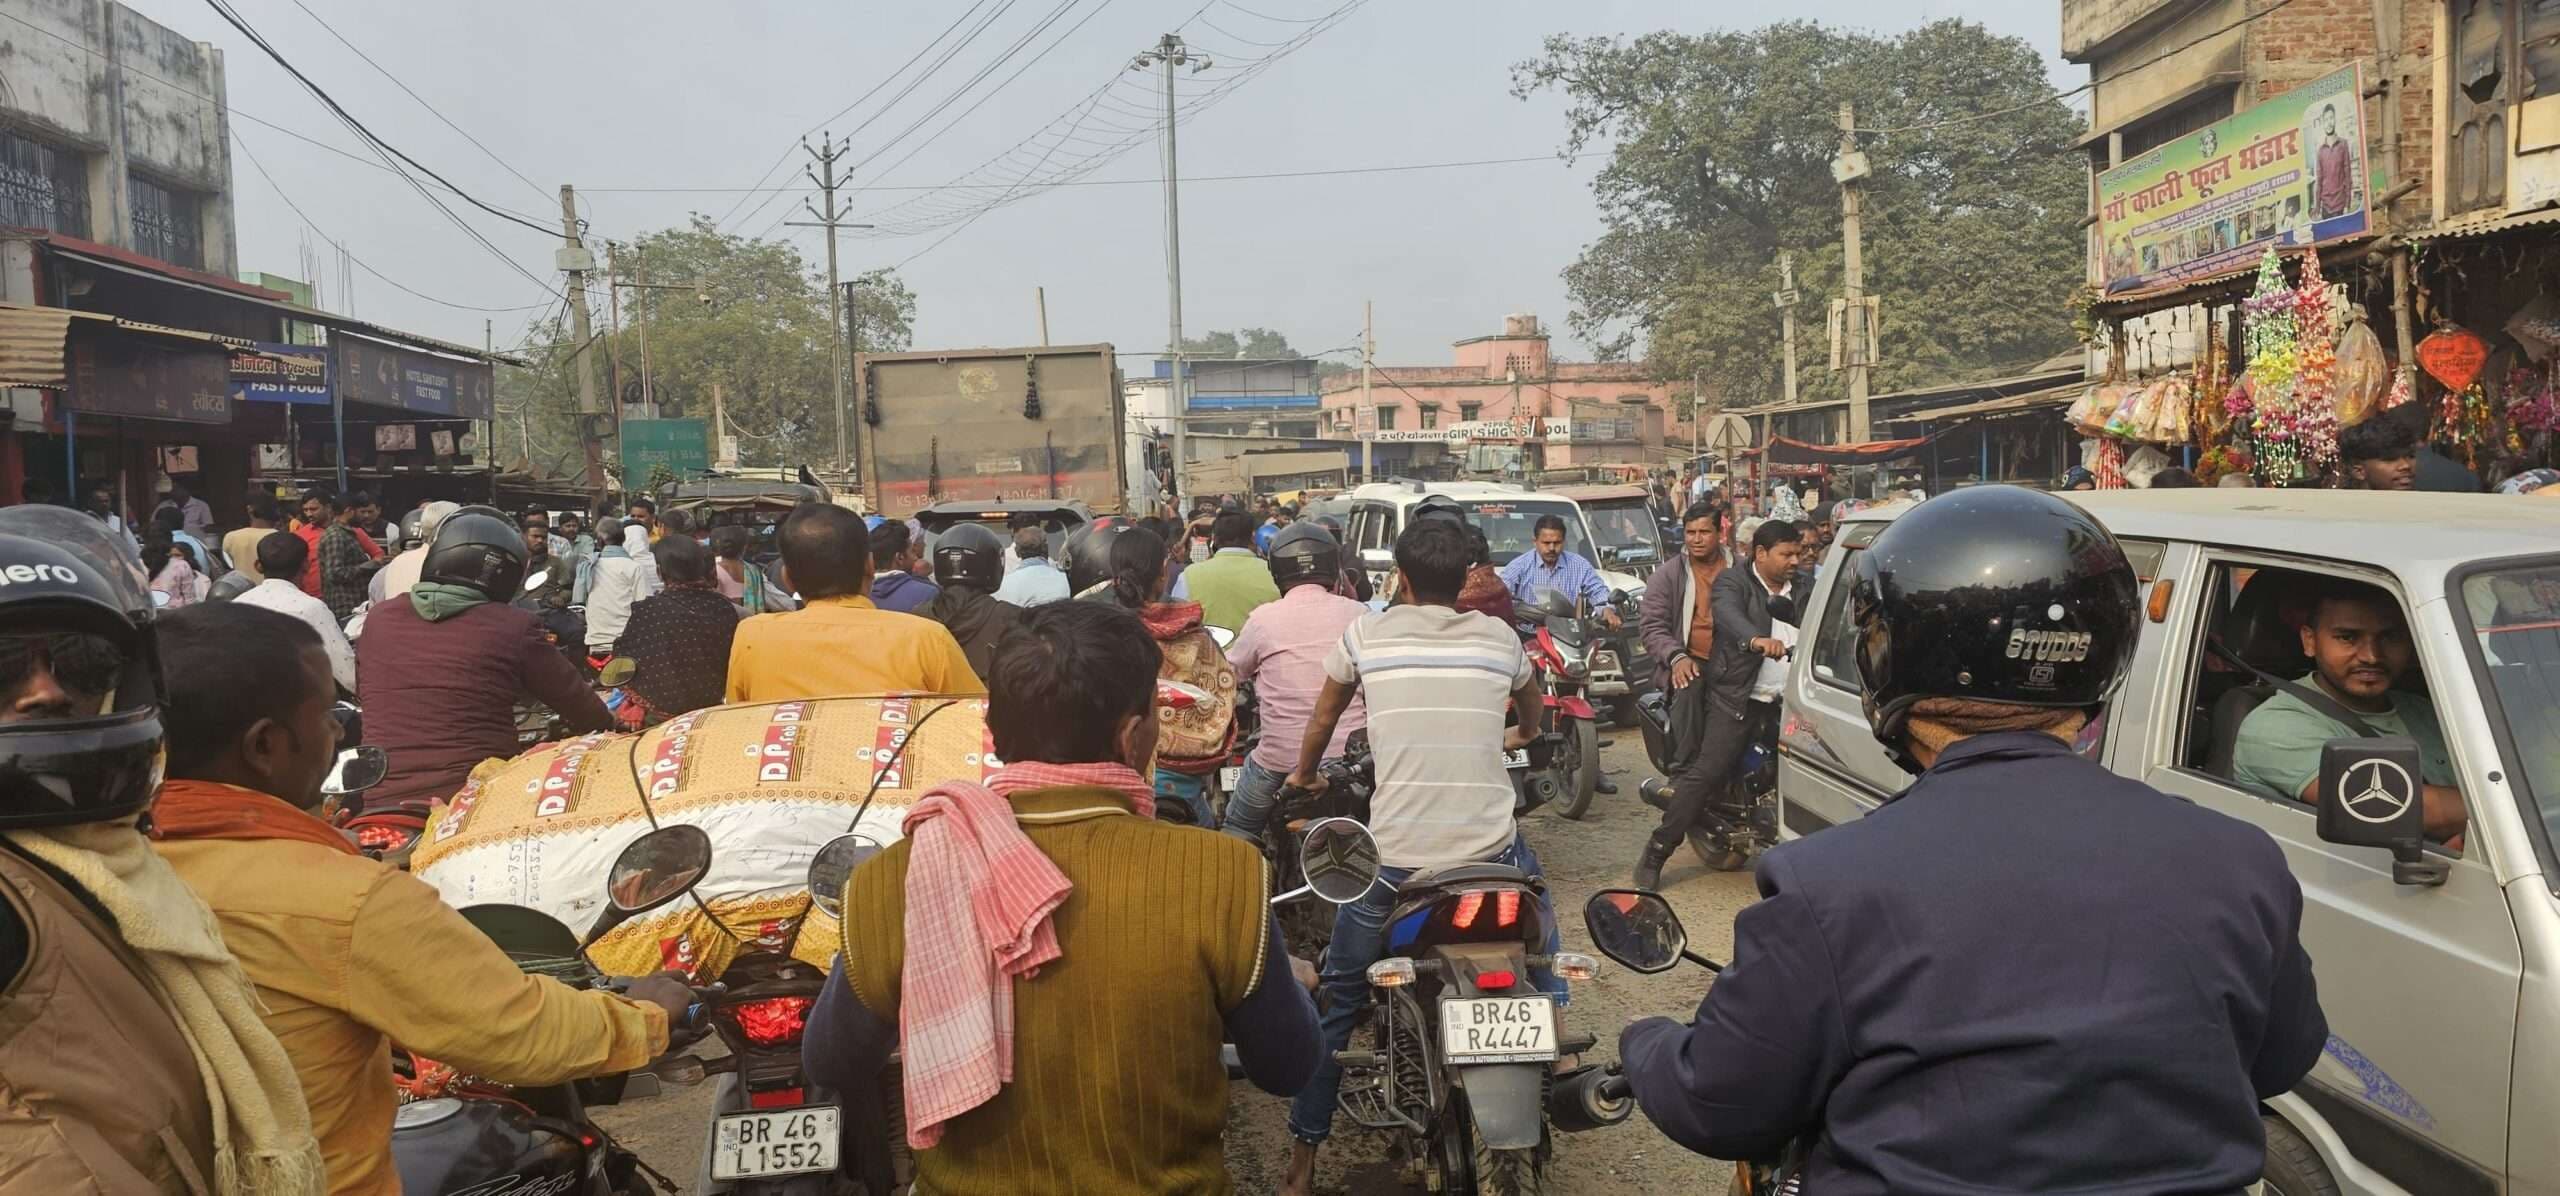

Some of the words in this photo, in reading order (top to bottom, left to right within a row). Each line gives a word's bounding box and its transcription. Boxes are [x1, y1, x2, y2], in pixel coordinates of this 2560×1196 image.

[2130, 170, 2183, 214] काली
[2187, 154, 2232, 199] फूल
[2238, 127, 2299, 171] भंडार
[251, 382, 284, 393] FAST
[288, 384, 327, 394] FOOD
[2005, 628, 2092, 662] STUDDS
[760, 725, 797, 780] D.P.fab
[1472, 1000, 1532, 1025] BR46
[1467, 1025, 1542, 1050] R4447
[739, 1116, 772, 1145] BR
[783, 1114, 817, 1140] 46
